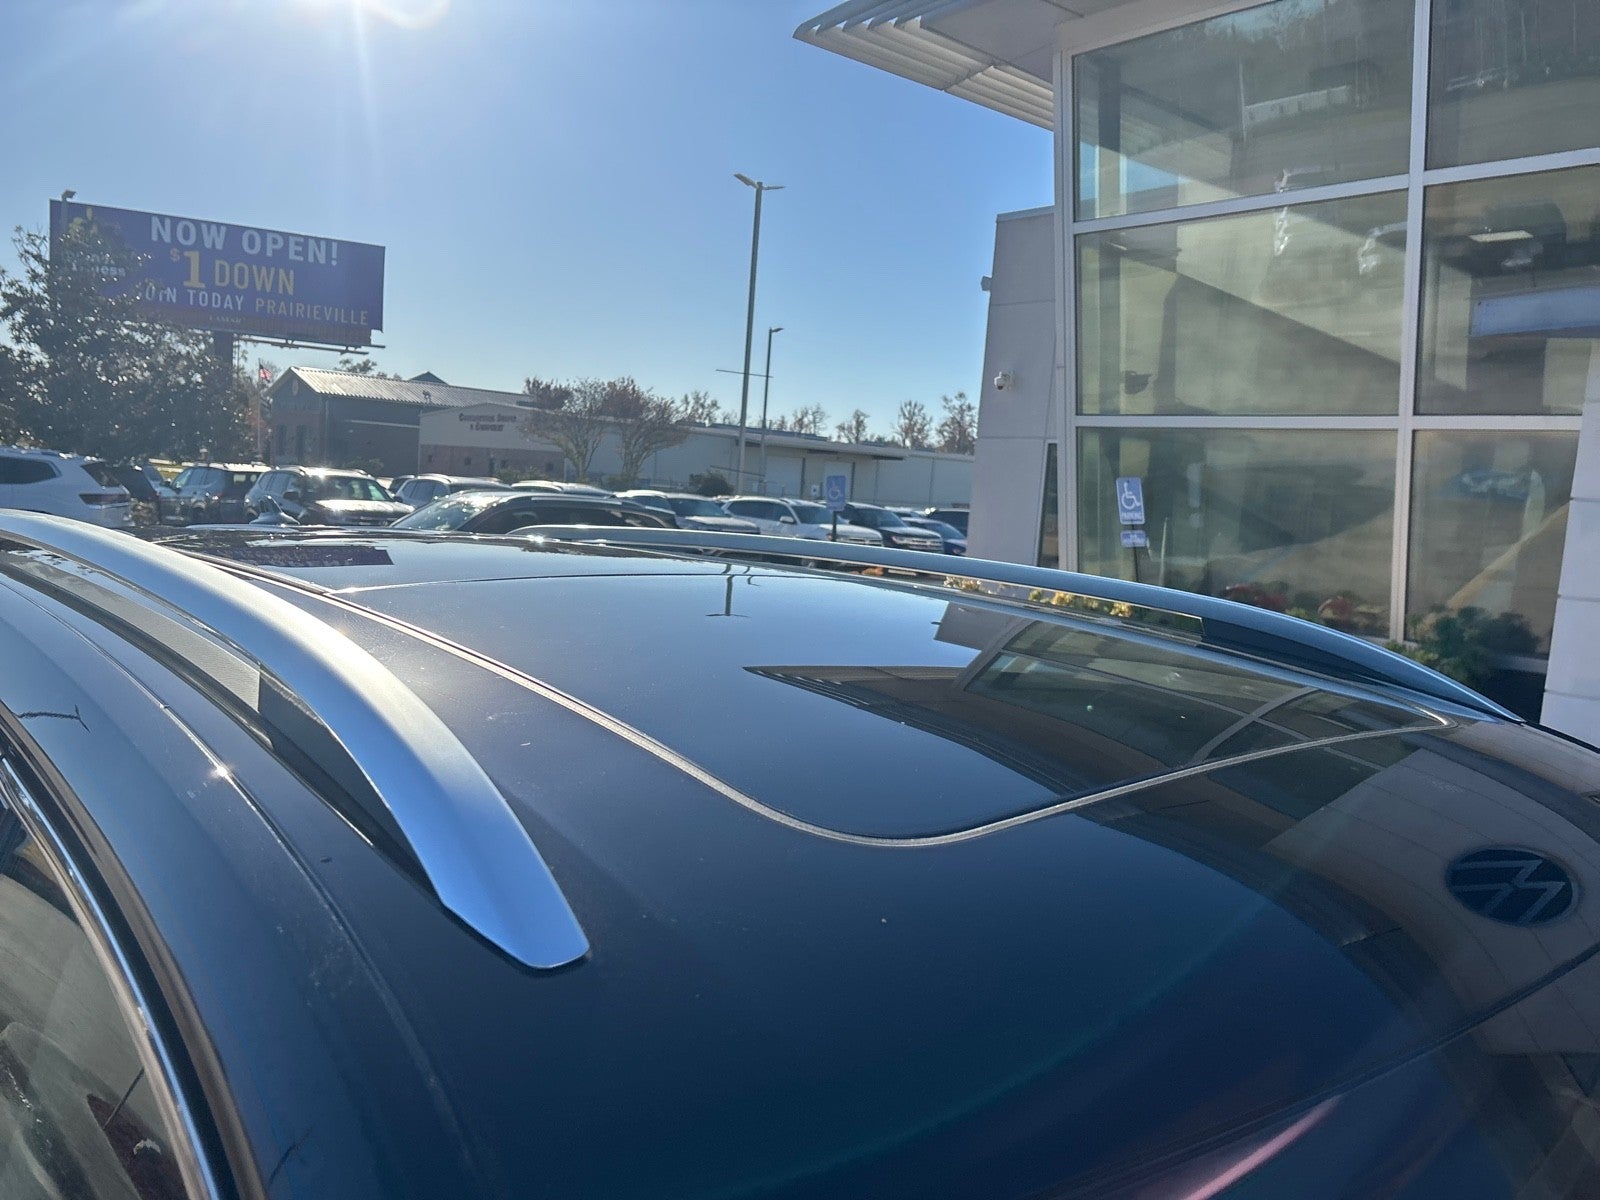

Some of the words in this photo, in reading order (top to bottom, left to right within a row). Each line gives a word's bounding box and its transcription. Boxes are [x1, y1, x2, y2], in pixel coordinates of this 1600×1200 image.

[151, 215, 227, 250] NOW
[241, 229, 338, 267] OPEN!
[214, 259, 294, 296] DOWN
[187, 289, 244, 311] TODAY
[255, 298, 369, 326] PRAIRIEVILLE
